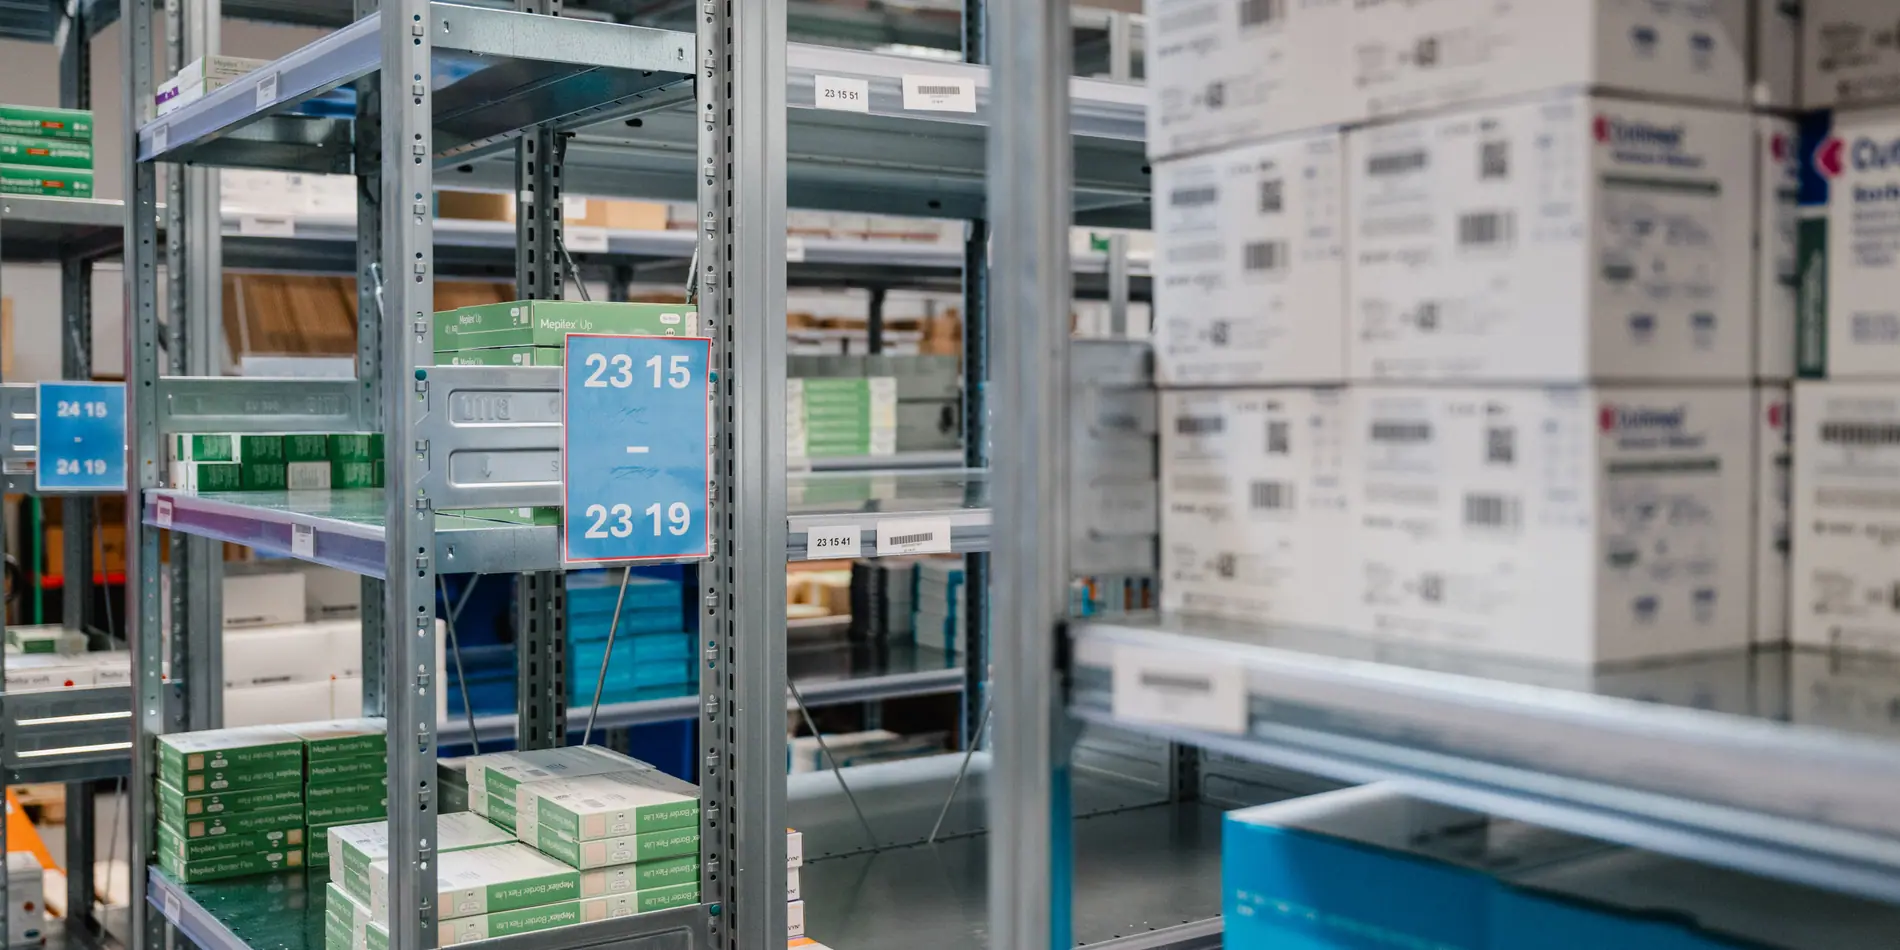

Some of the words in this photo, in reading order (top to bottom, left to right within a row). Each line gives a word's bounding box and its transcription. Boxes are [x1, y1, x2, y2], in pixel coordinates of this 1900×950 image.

[825, 88, 835, 98] 23
[838, 90, 847, 99] 15
[850, 91, 859, 100] 51
[540, 318, 577, 331] Mepilex
[580, 320, 593, 331] Up
[584, 353, 633, 388] 23
[645, 355, 691, 389] 15
[57, 400, 81, 417] 24
[85, 401, 107, 418] 15
[56, 459, 80, 475] 24
[84, 459, 107, 475] 19
[584, 503, 634, 539] 23
[645, 501, 691, 537] 19
[816, 538, 827, 547] 23
[830, 538, 839, 547] 15
[841, 537, 851, 546] 41
[669, 807, 690, 818] Border
[670, 835, 691, 845] Border
[669, 864, 690, 873] Border
[523, 884, 546, 895] Border
[671, 892, 692, 901] Border
[525, 915, 547, 926] Border
